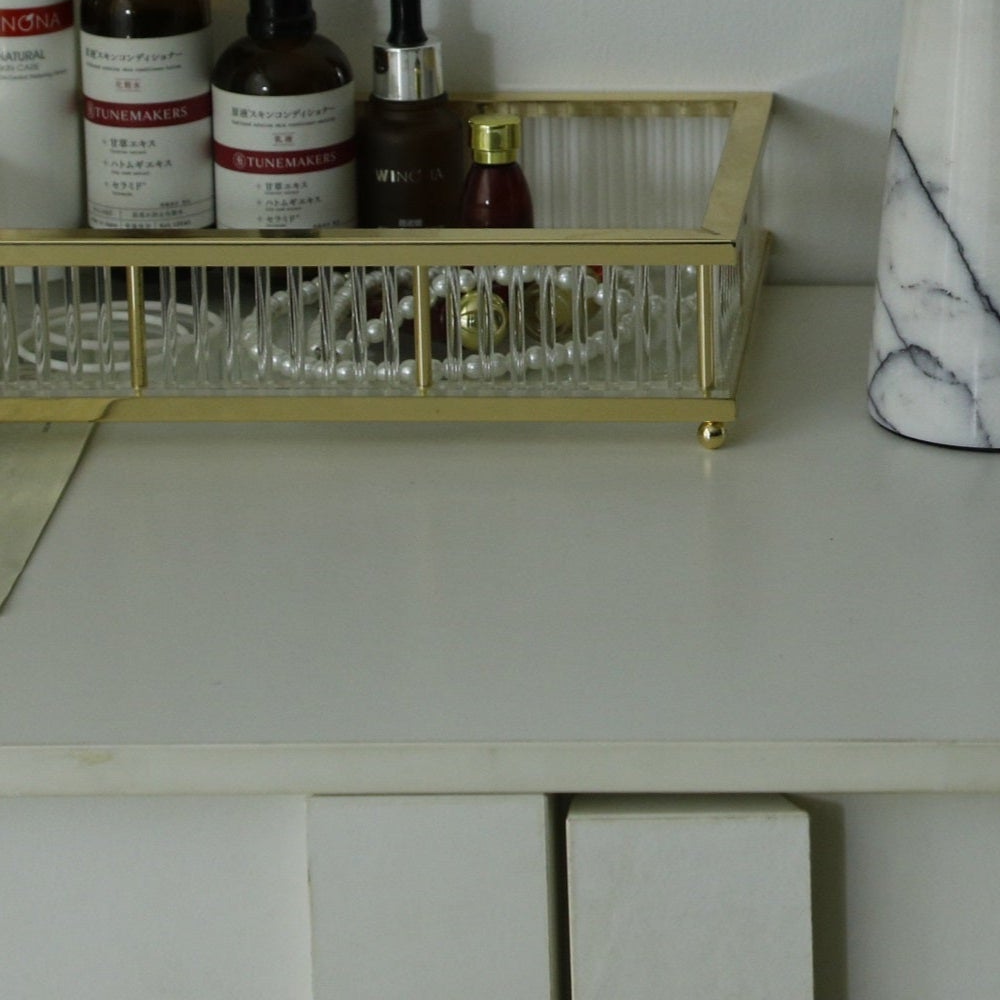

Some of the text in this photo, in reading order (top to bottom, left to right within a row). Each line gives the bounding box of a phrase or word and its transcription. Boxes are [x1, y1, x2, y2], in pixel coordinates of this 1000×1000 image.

[0, 12, 61, 33] NONA
[94, 106, 189, 122] TUNEMAKERS
[247, 152, 337, 169] TUNEMAKERS
